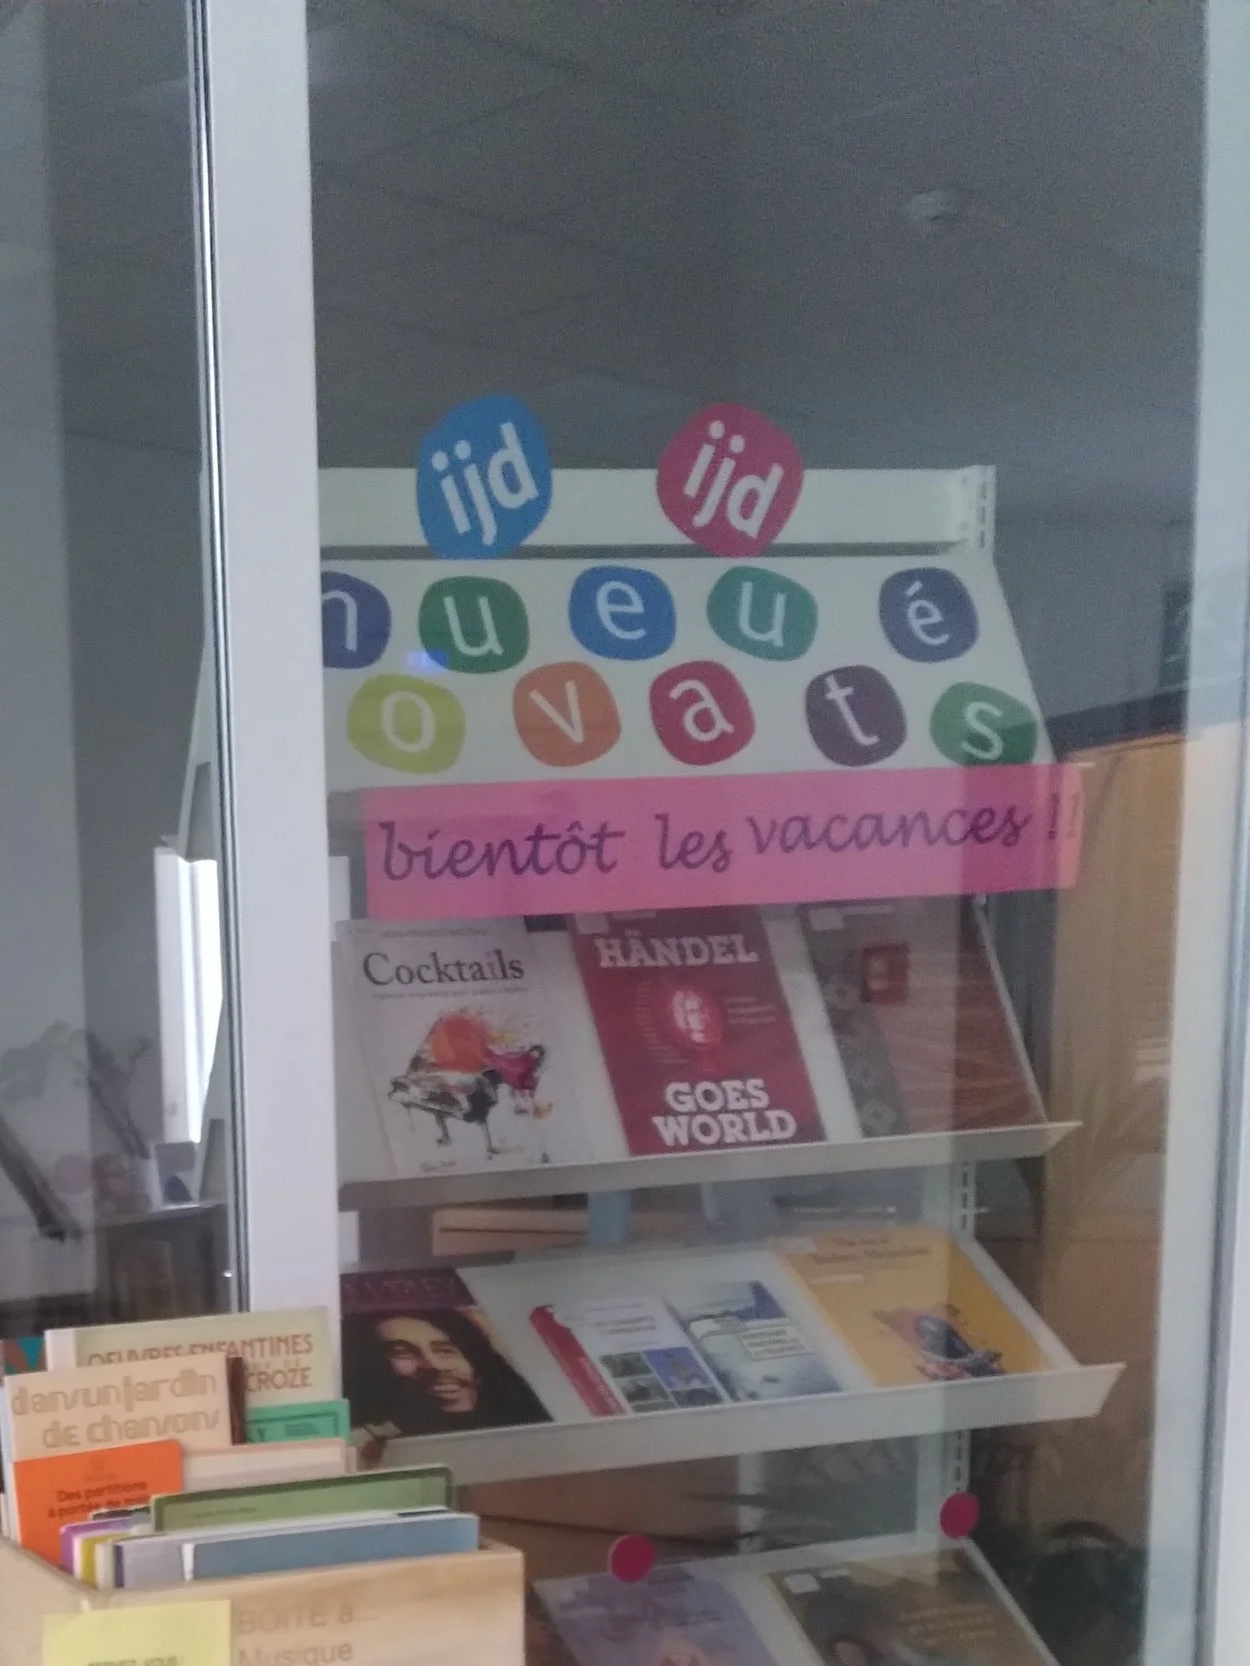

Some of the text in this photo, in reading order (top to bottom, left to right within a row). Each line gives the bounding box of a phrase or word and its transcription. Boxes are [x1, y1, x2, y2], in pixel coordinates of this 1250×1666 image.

[431, 421, 540, 547] ijd
[682, 419, 785, 541] ijd
[379, 817, 627, 881] bientôt
[655, 813, 732, 874] les
[744, 803, 1033, 856] vacances
[362, 947, 526, 987] Cocktails
[594, 929, 760, 969] HÄNDEL
[664, 1077, 771, 1113] GOES
[652, 1109, 798, 1147] WORLD
[244, 1366, 314, 1393] CROZE
[43, 1421, 81, 1450] de
